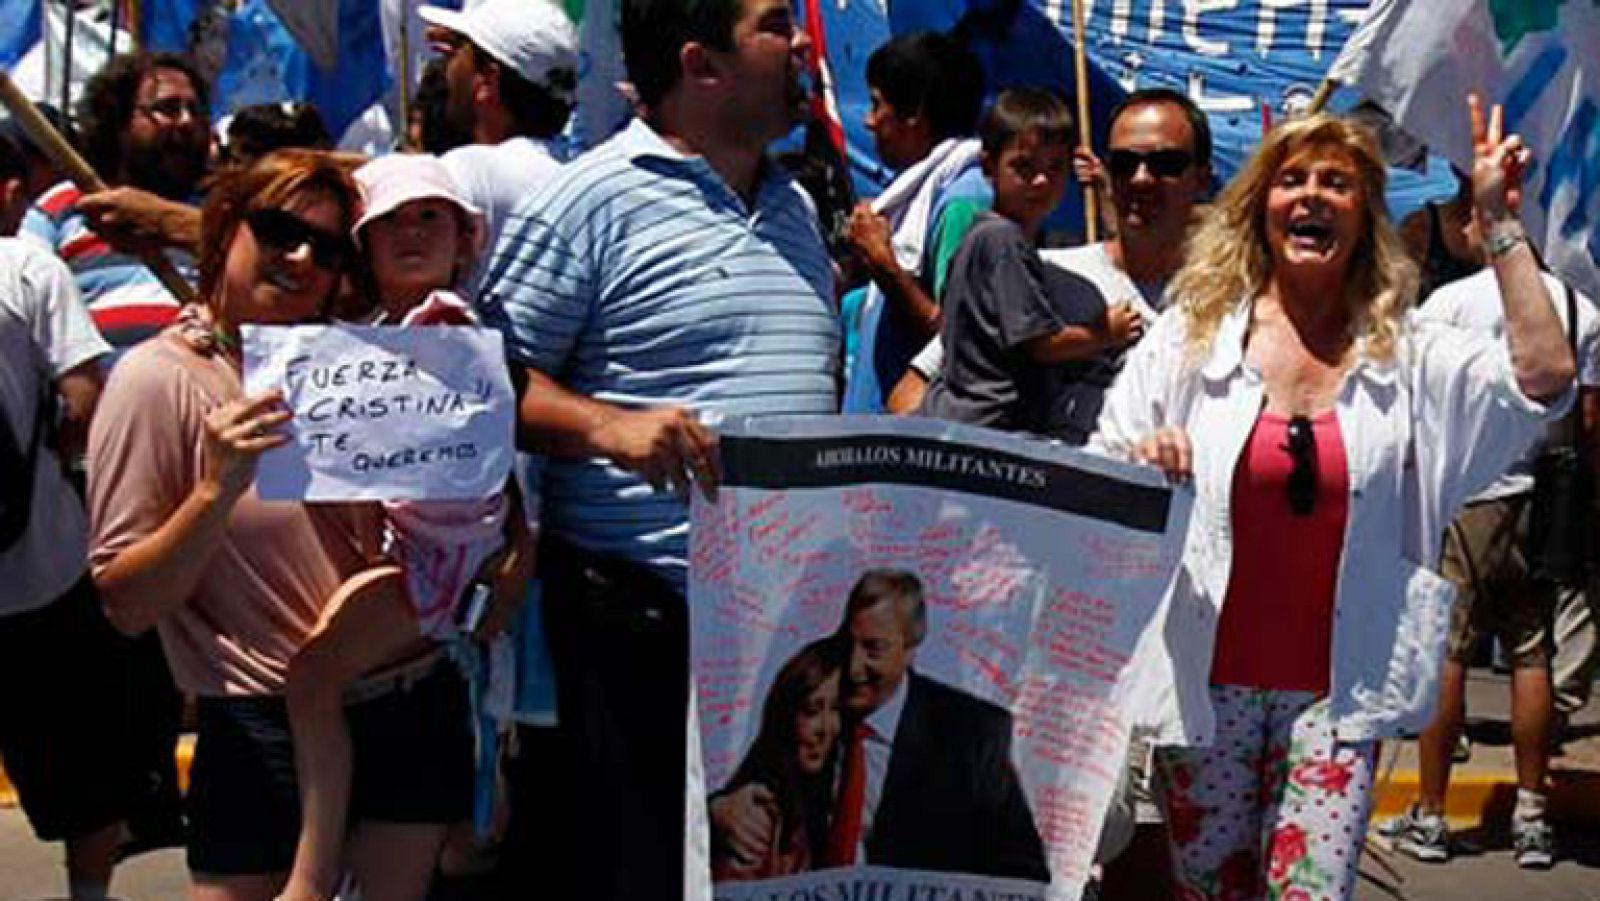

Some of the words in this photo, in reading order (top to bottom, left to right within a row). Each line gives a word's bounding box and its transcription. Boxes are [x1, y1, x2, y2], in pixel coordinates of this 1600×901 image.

[286, 355, 418, 391] FUERZA
[308, 433, 349, 455] TE
[353, 442, 478, 473] QUEREMOS
[903, 448, 1047, 488] MILITANTES
